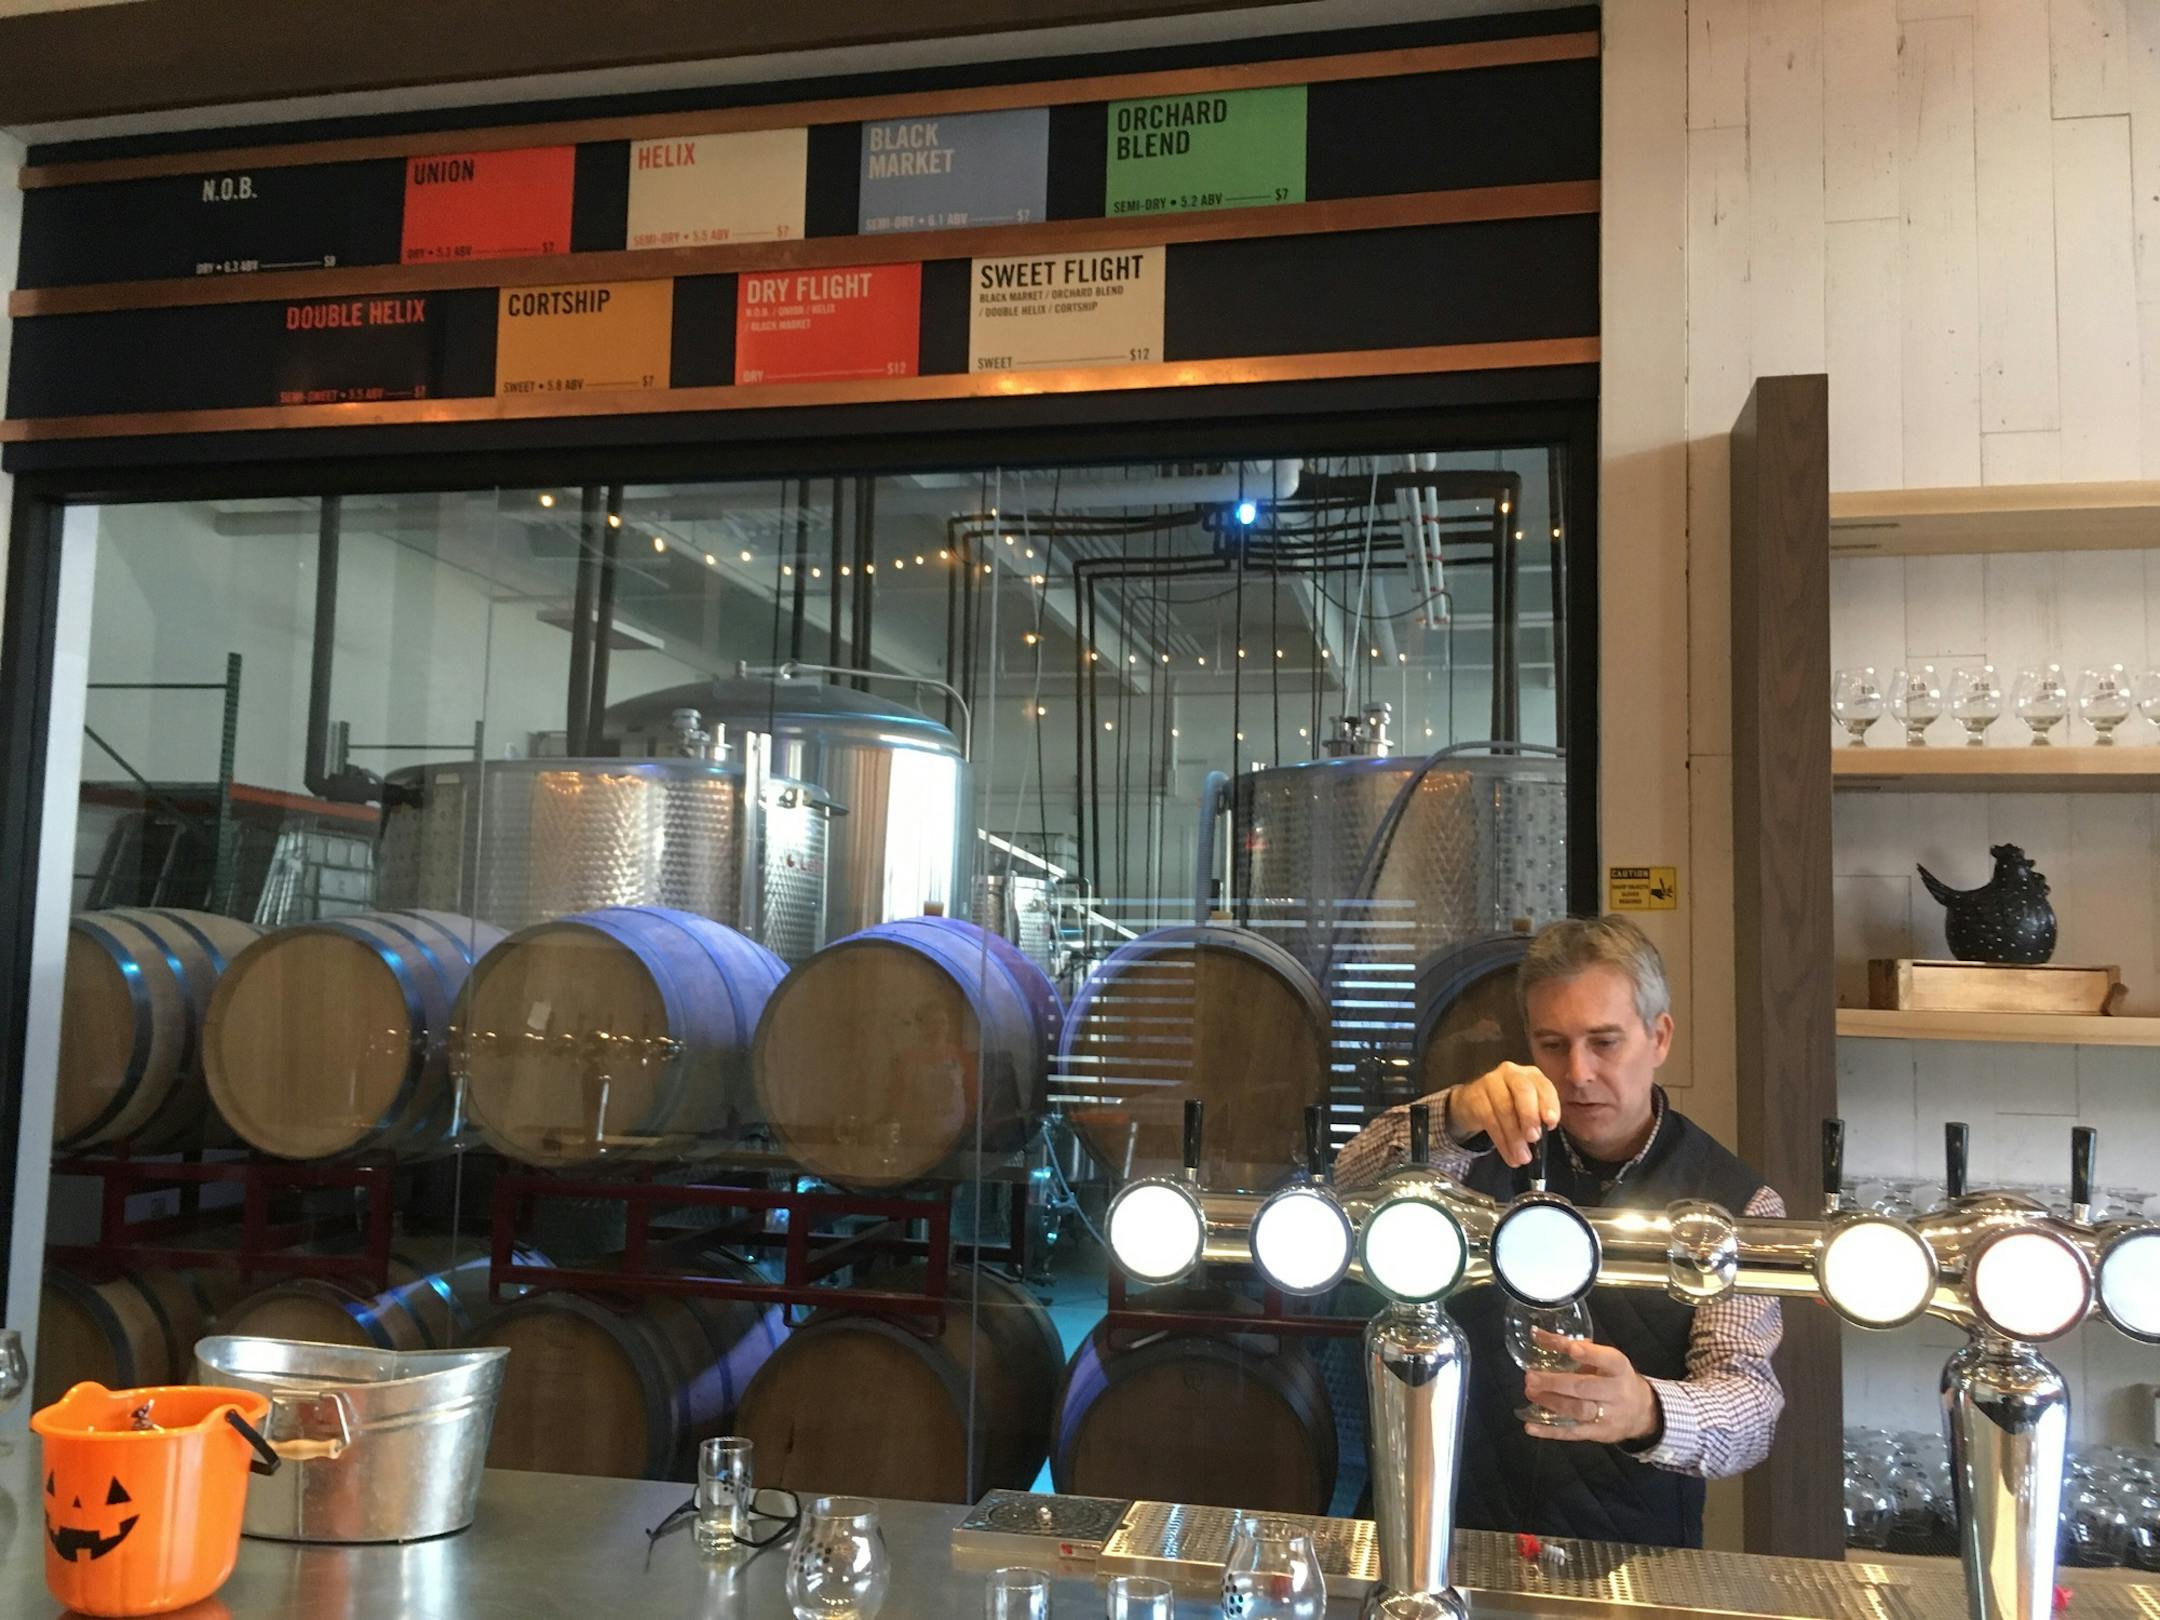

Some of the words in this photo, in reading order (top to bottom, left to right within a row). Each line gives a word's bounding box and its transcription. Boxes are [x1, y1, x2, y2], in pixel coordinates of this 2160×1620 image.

[1117, 98, 1228, 133] ORCHARD
[870, 123, 940, 152] BLACK
[1116, 130, 1190, 161] BLEND
[638, 142, 696, 170] HELIX
[868, 149, 955, 179] MARKET
[414, 159, 475, 185] UNION
[203, 176, 258, 202] N.O.B.
[1113, 197, 1167, 214] SEMI-DRY
[1180, 195, 1197, 208] 5.2
[1200, 193, 1223, 206] ABV
[1275, 187, 1289, 201] $7
[865, 215, 915, 232] SEMI-DRY
[946, 212, 968, 226] ABV
[1016, 208, 1031, 223] $7
[632, 231, 680, 247] SEMI-DRY
[711, 228, 730, 241] ABV
[981, 260, 1056, 289] SWEET
[1064, 255, 1144, 285] FLIGHT
[746, 278, 790, 304] DRY
[796, 273, 873, 302] FLIGHT
[979, 292, 1007, 304] BLACK
[1009, 290, 1043, 302] MARKET
[1051, 287, 1093, 300] ORCHARD
[1095, 285, 1125, 297] BLEND
[286, 302, 363, 330] DOUBLE
[369, 299, 426, 325] HELIX
[508, 289, 611, 317] CORTSHIP
[985, 305, 1018, 318] DOUBLE
[1021, 303, 1046, 316] HELIX
[1054, 301, 1098, 314] CORTSHIP
[778, 318, 811, 331] MARKET
[977, 356, 1013, 370] SWEET
[1129, 347, 1150, 362] $12
[503, 380, 535, 394] SWEET
[565, 378, 584, 391] ABV
[642, 375, 655, 388] $7
[743, 370, 764, 382] DRY
[887, 362, 907, 376] $12
[1611, 869, 1649, 878] CAUTION
